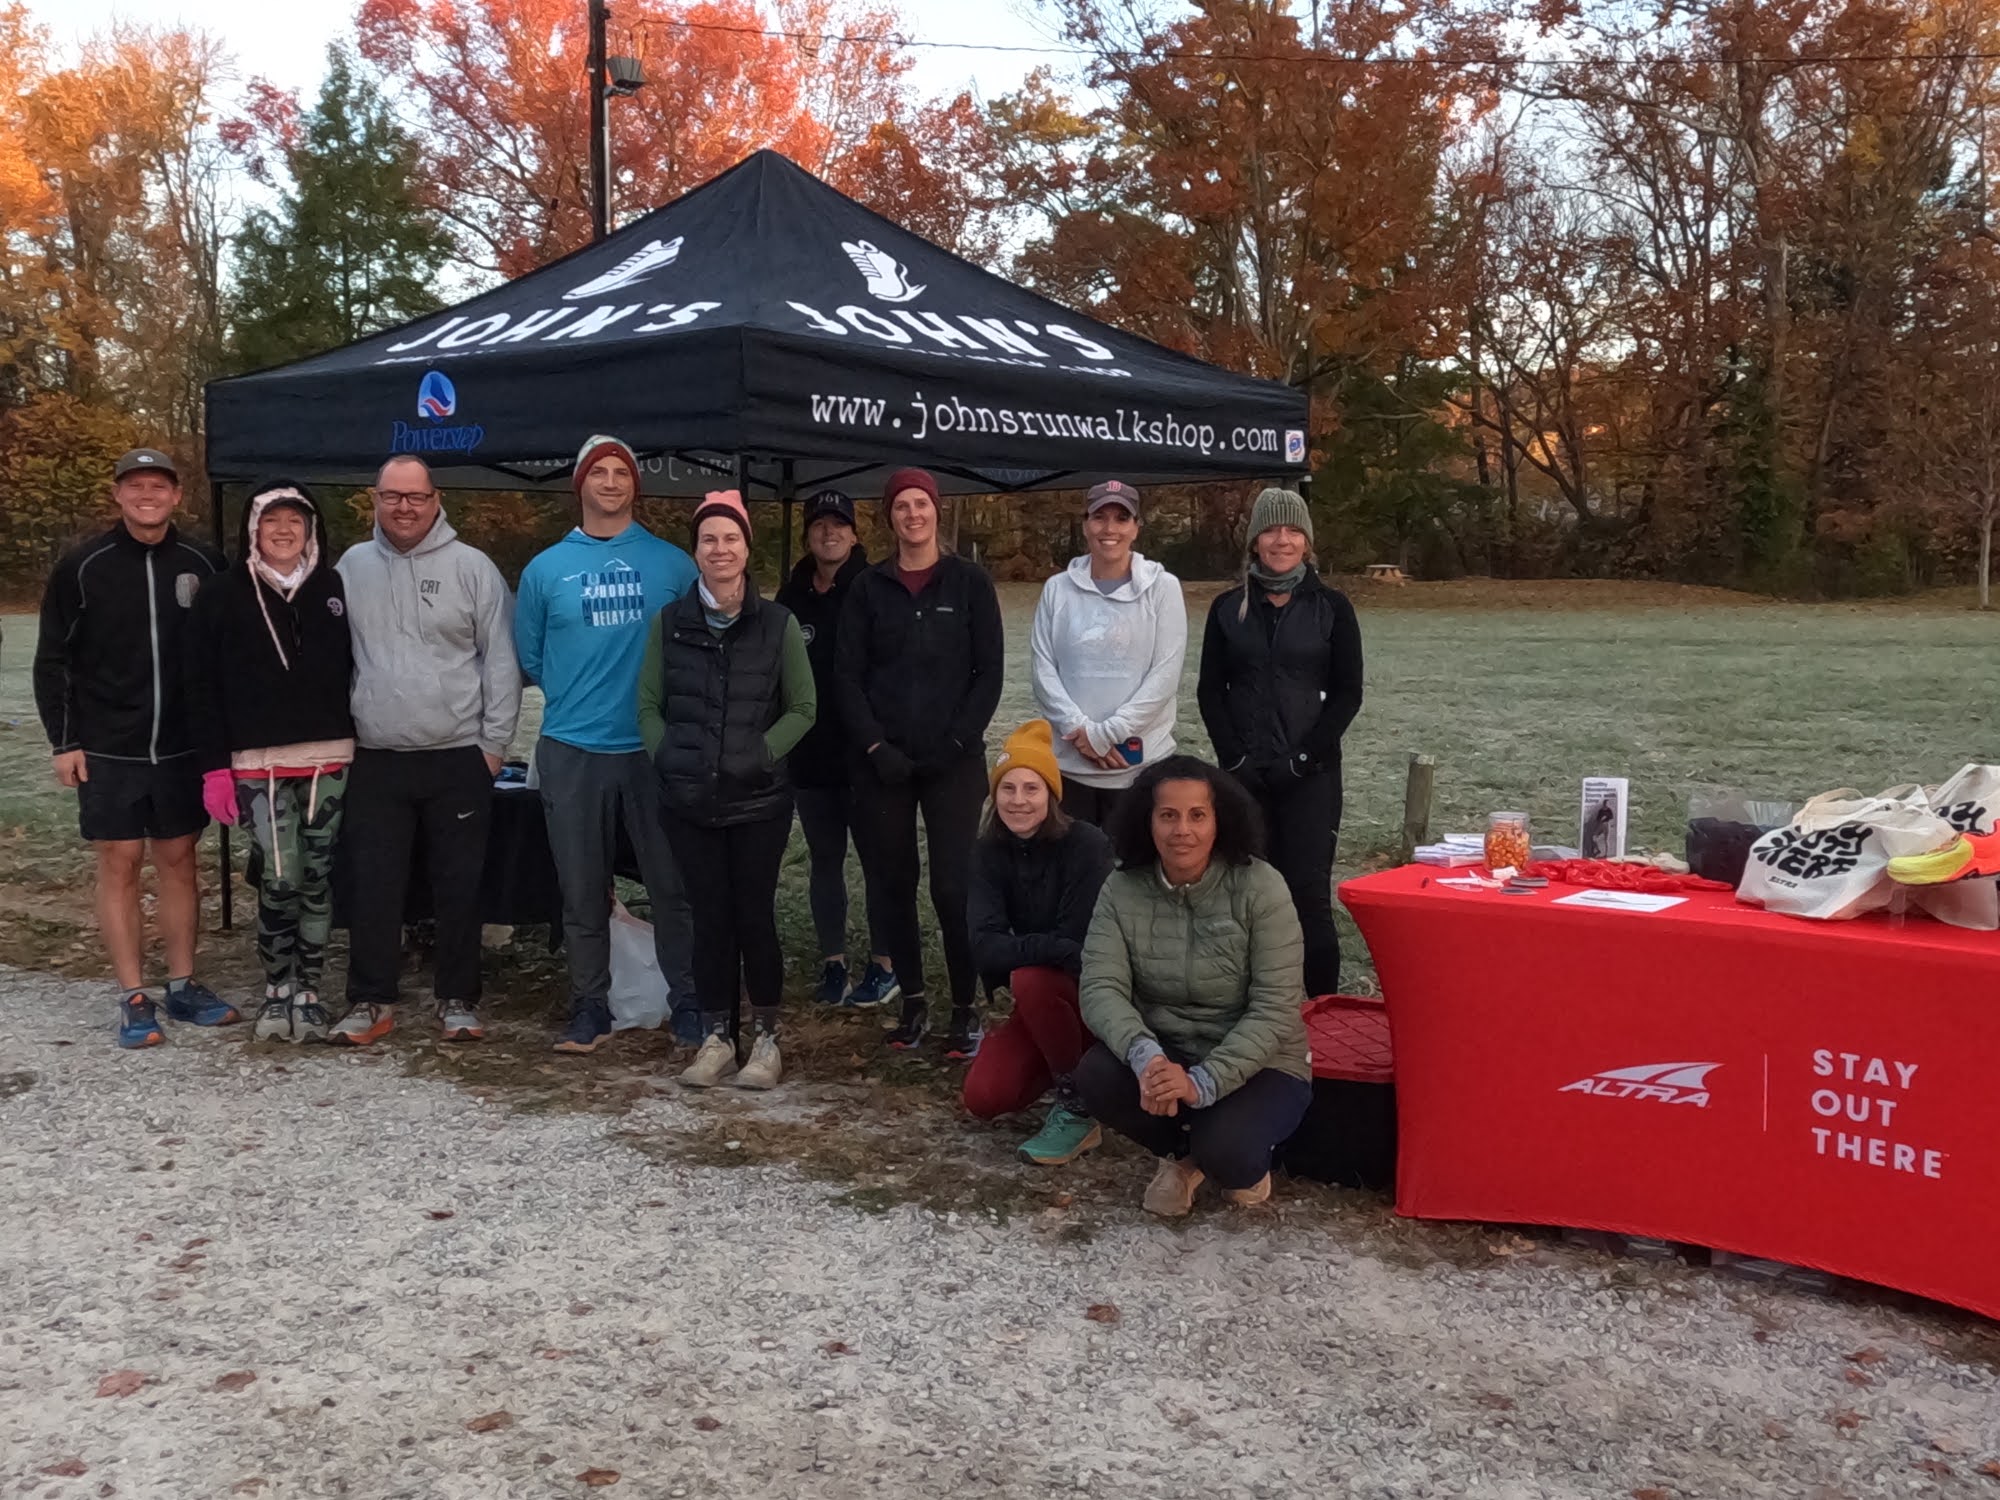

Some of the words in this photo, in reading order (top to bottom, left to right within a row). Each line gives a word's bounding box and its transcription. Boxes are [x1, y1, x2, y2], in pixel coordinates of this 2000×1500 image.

[386, 302, 722, 352] JOHN'S
[785, 300, 1115, 360] JOHN'S
[811, 391, 1278, 455] www.johnsrunwalkshop.com
[599, 583, 643, 598] HORSE
[593, 610, 625, 627] RELAY
[1813, 1049, 1918, 1090] STAY
[1558, 1078, 1711, 1108] ALTRA
[1812, 1089, 1897, 1127] OUT
[1812, 1127, 1942, 1179] THERE
